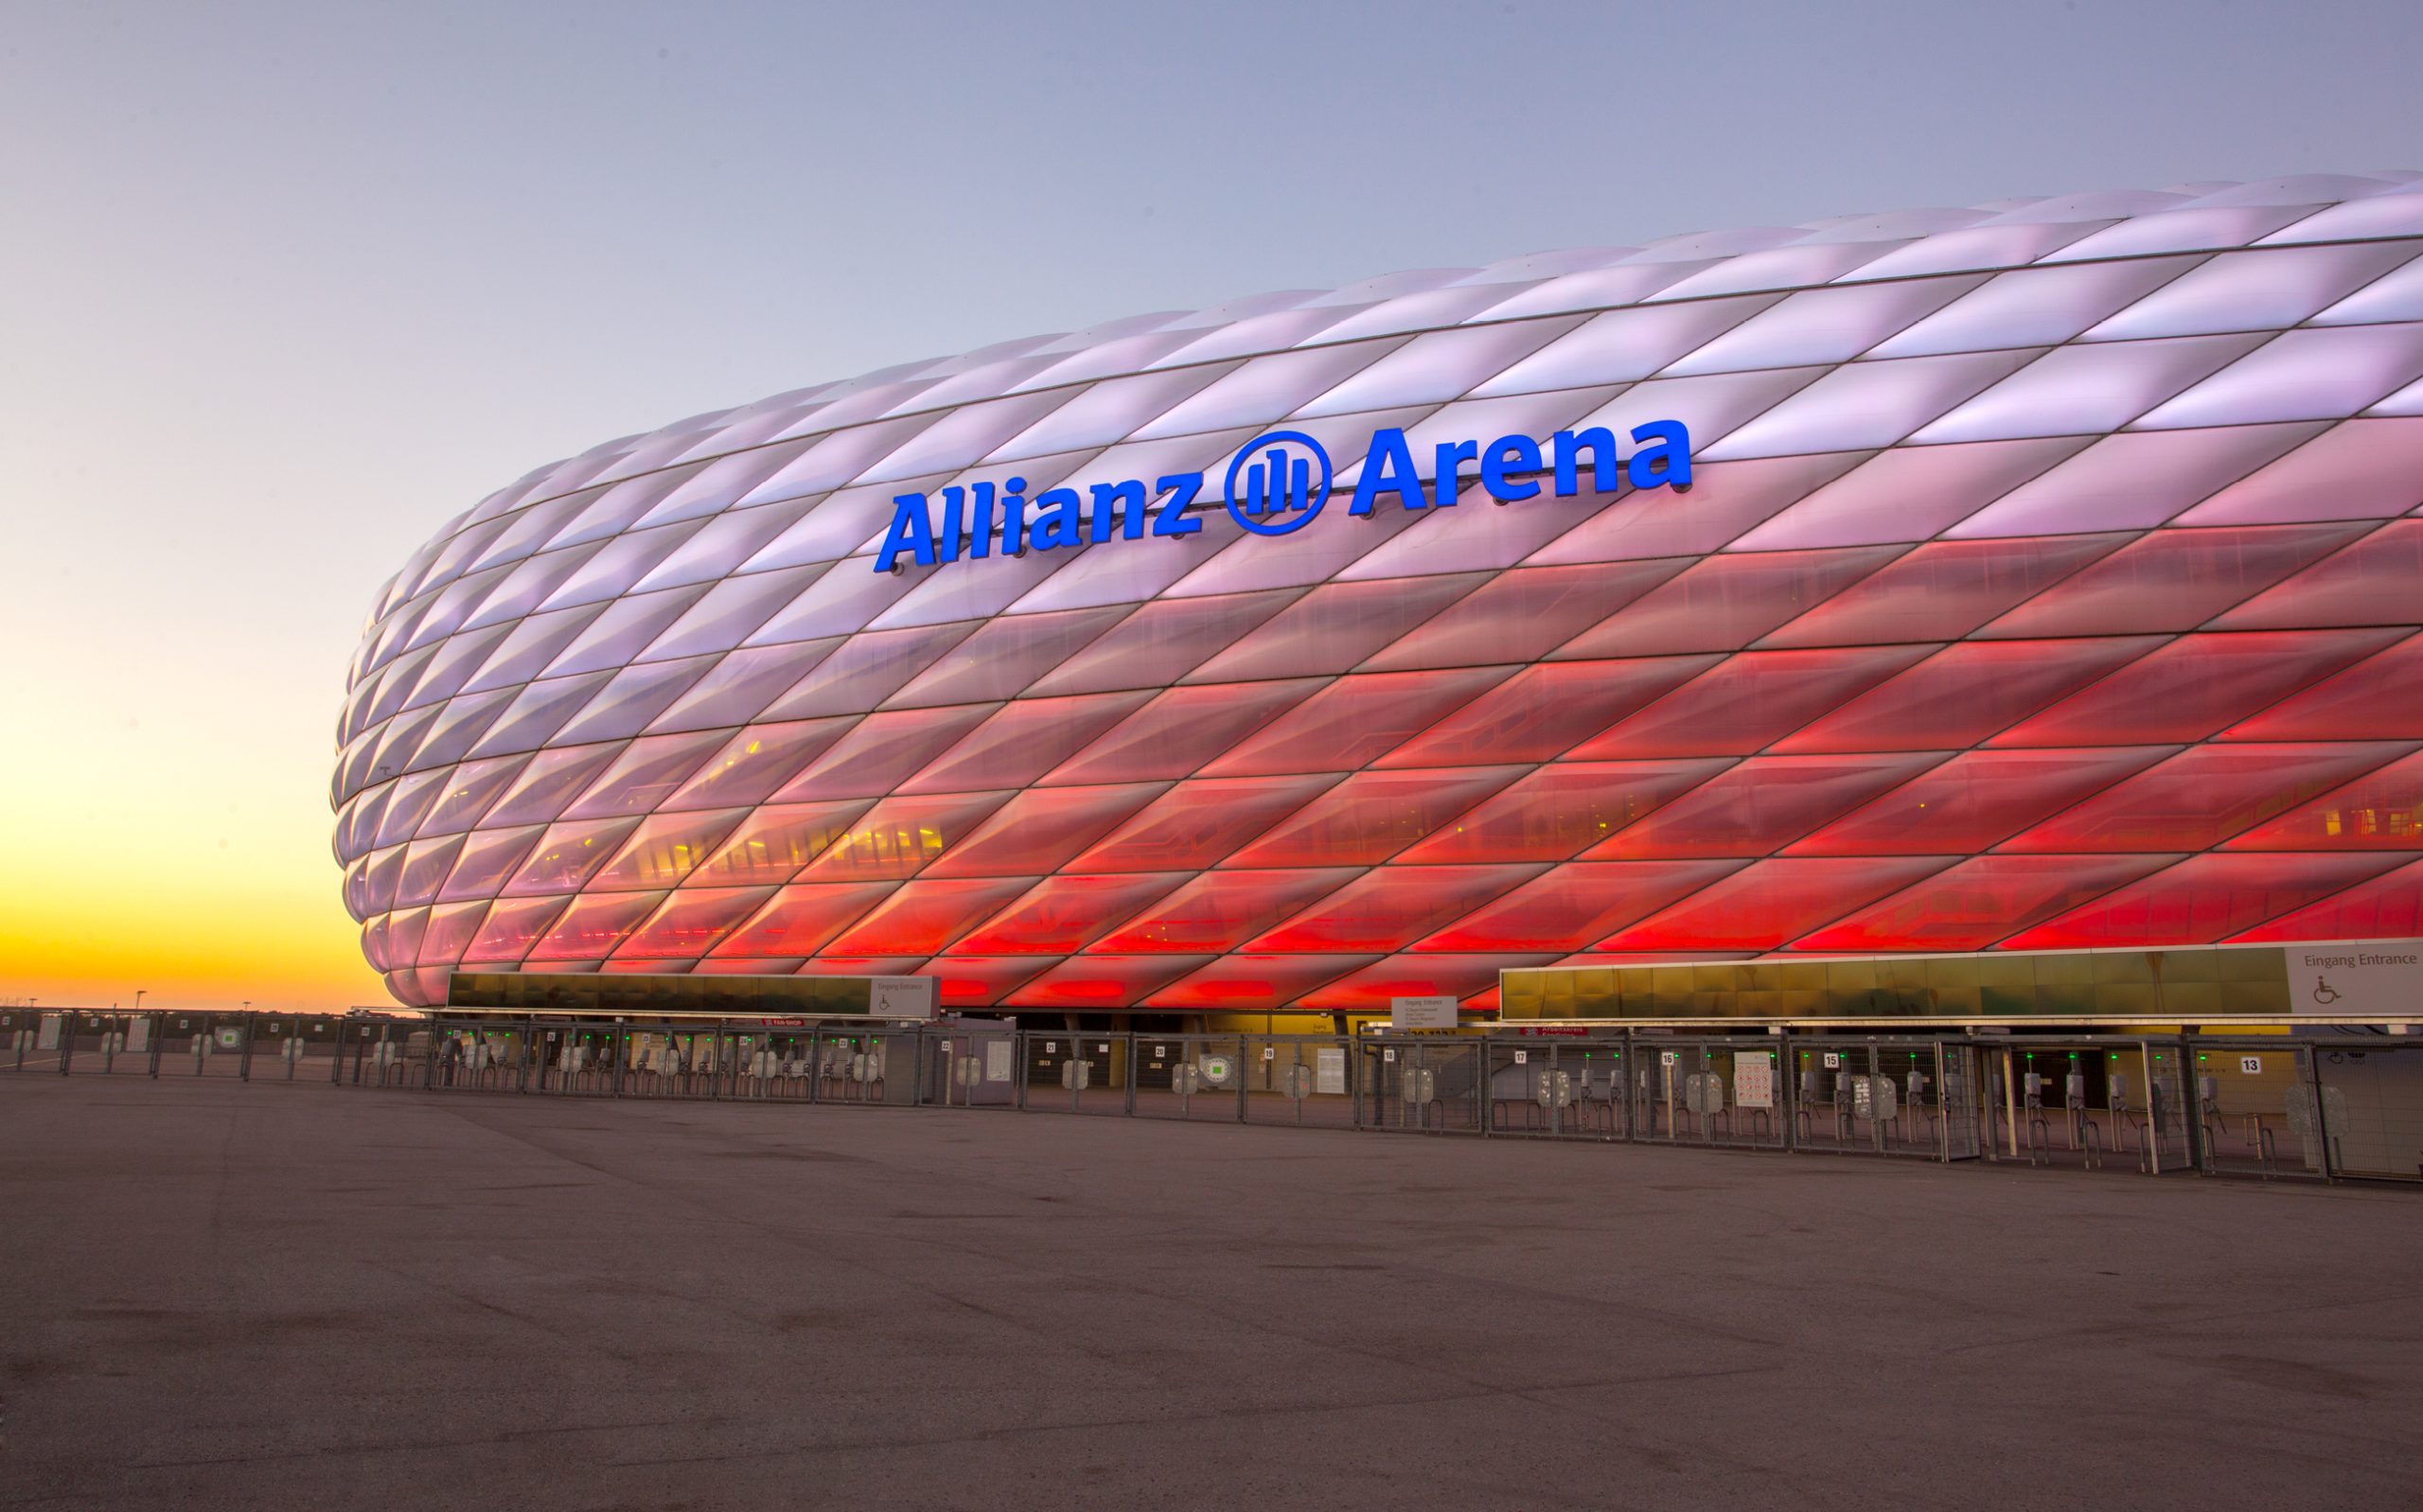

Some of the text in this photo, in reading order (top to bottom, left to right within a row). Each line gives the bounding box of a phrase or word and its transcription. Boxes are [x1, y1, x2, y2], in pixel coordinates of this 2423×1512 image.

[875, 419, 1694, 573] Allianz Arena
[2305, 954, 2417, 969] Eingang Entrance
[1516, 1052, 1525, 1061] 17
[1664, 1054, 1672, 1064] 16
[1827, 1055, 1836, 1064] 15
[2243, 1060, 2257, 1070] 13
